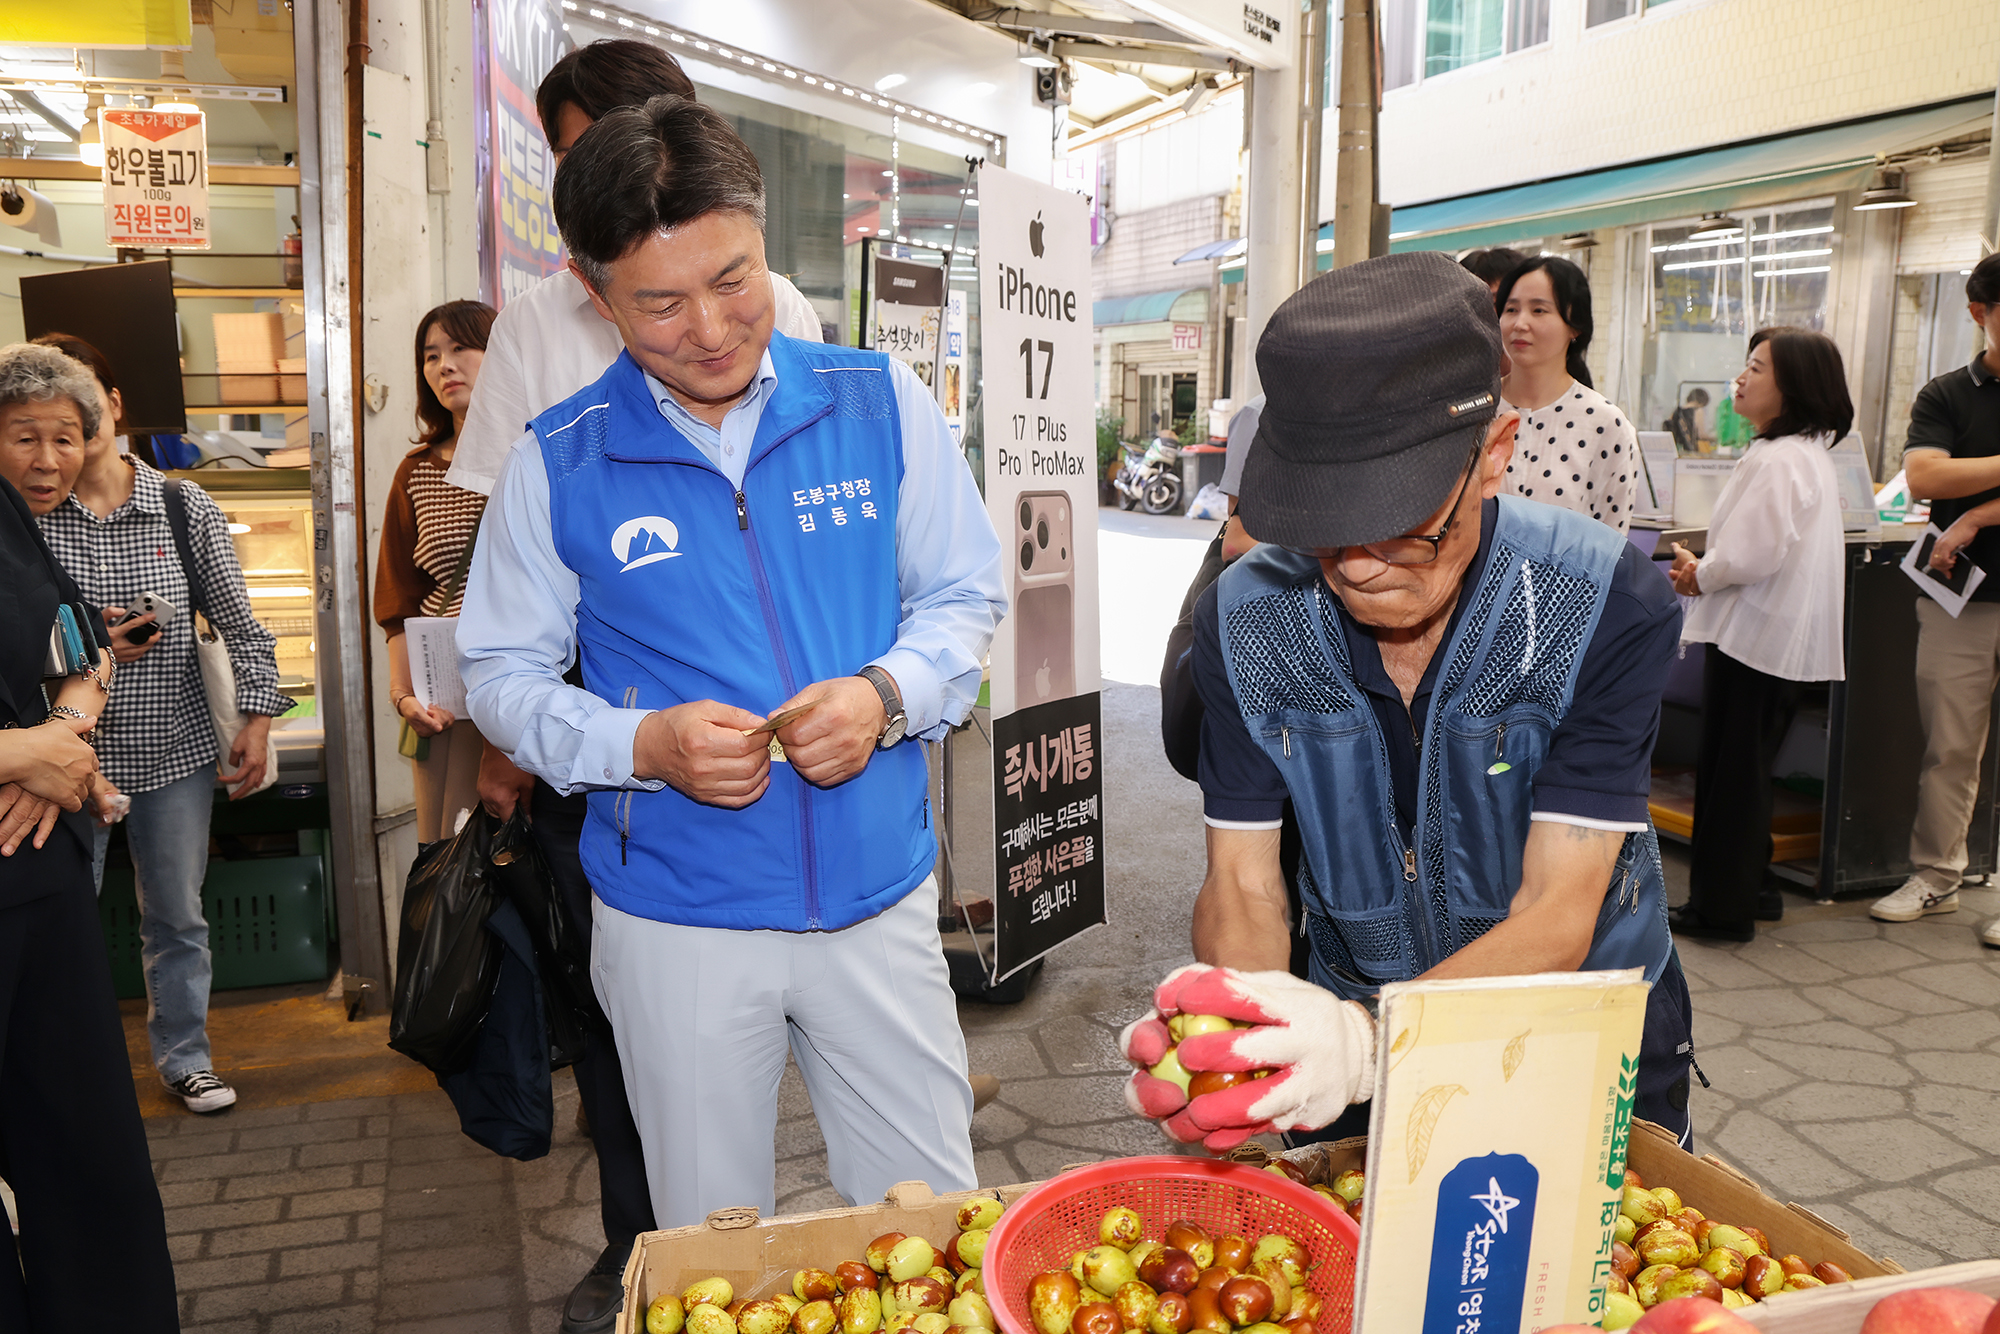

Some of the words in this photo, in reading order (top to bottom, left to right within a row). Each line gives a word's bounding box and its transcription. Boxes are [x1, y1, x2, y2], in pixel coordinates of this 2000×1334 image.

[120, 113, 158, 127] 초특가
[162, 114, 187, 129] 세일
[107, 147, 204, 188] 한우불고기
[143, 189, 171, 201] 100g
[114, 204, 191, 235] 직원문의
[193, 217, 204, 231] 원
[893, 277, 917, 288] SAMSUNG
[998, 262, 1077, 323] iPhone
[877, 324, 925, 351] 추석맞이
[1173, 324, 1202, 349] 유리
[1019, 337, 1054, 400] 17
[1012, 414, 1026, 440] 17
[1037, 416, 1067, 441] Plus
[999, 448, 1022, 475] Pro
[1032, 450, 1085, 476] ProMax
[792, 477, 872, 507] 도봉구청장
[797, 512, 816, 533] 김
[831, 506, 848, 526] 동
[860, 501, 878, 520] 욱
[1004, 723, 1094, 802] 즉시개통
[1001, 813, 1054, 858] 구매하시는
[1055, 794, 1098, 832] 모든분께
[1008, 851, 1042, 898] 푸짐한
[1044, 835, 1094, 876] 사은품을
[1610, 1107, 1632, 1176] 身土不二
[1533, 1262, 1550, 1317] FRESH
